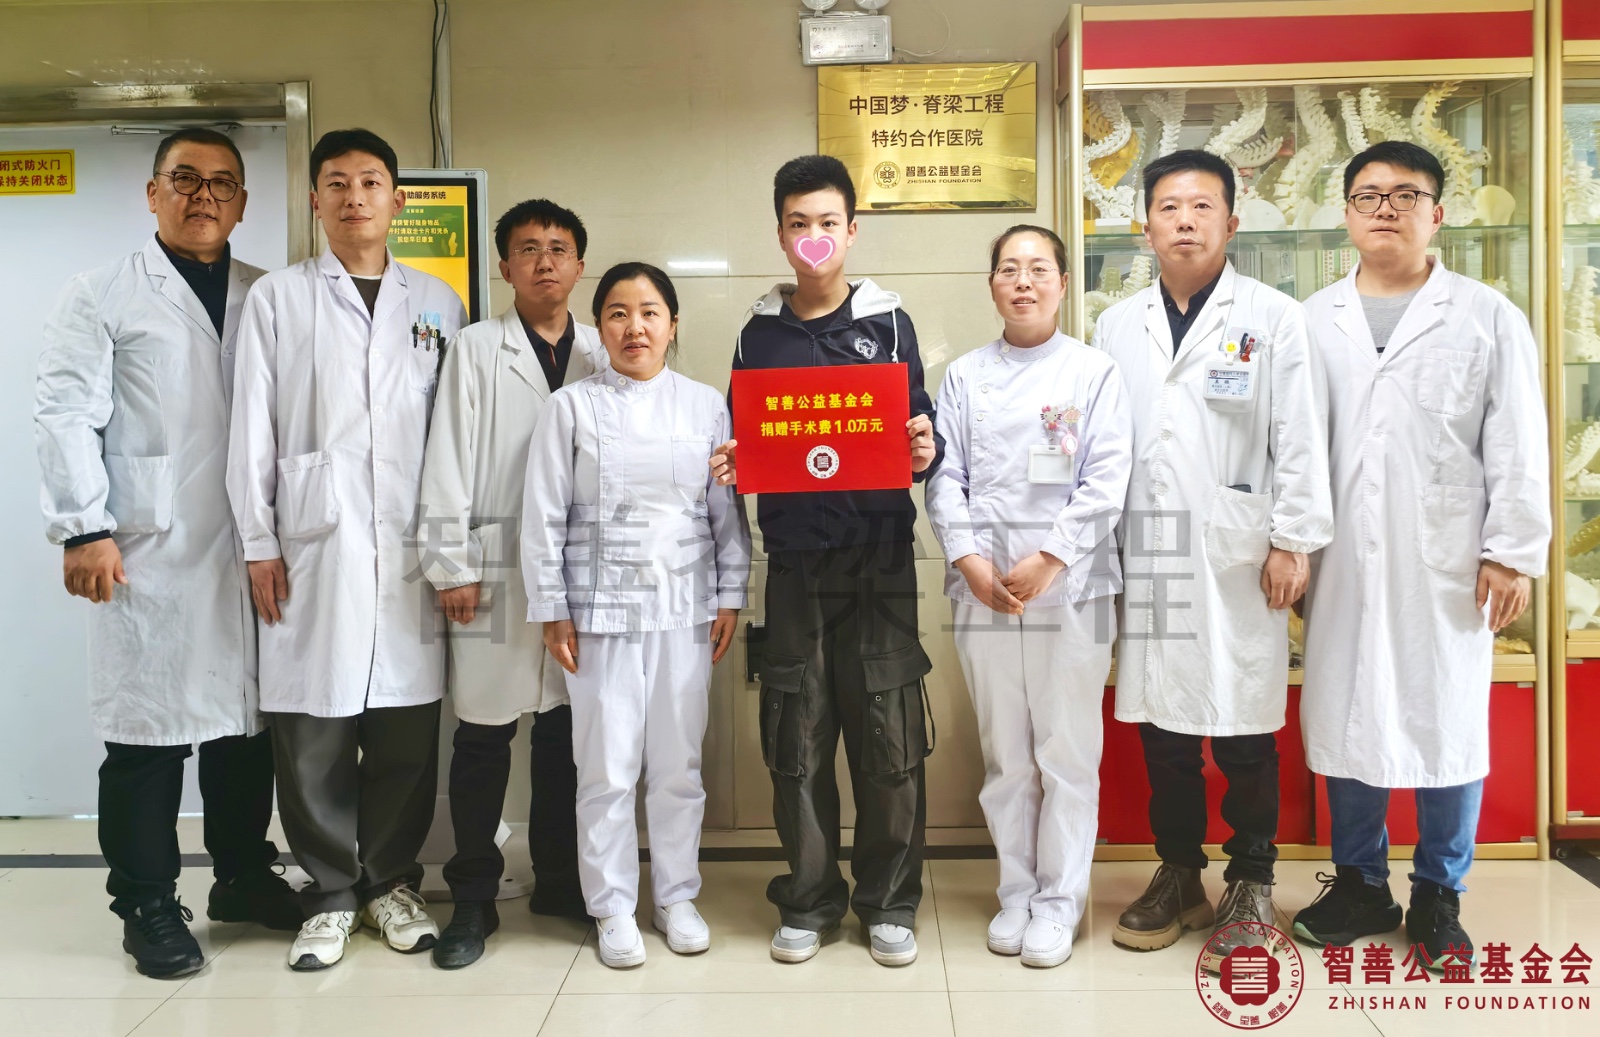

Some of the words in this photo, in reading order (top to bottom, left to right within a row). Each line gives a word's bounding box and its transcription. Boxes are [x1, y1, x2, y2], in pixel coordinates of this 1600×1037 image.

[849, 94, 1005, 116] 中国梦·脊梁工程
[871, 128, 983, 148] 特约合作医院
[905, 165, 982, 177] 智善公益基金会
[765, 392, 874, 411] 智善公益基金会
[760, 418, 884, 437] 捐赠手术费1.0万元
